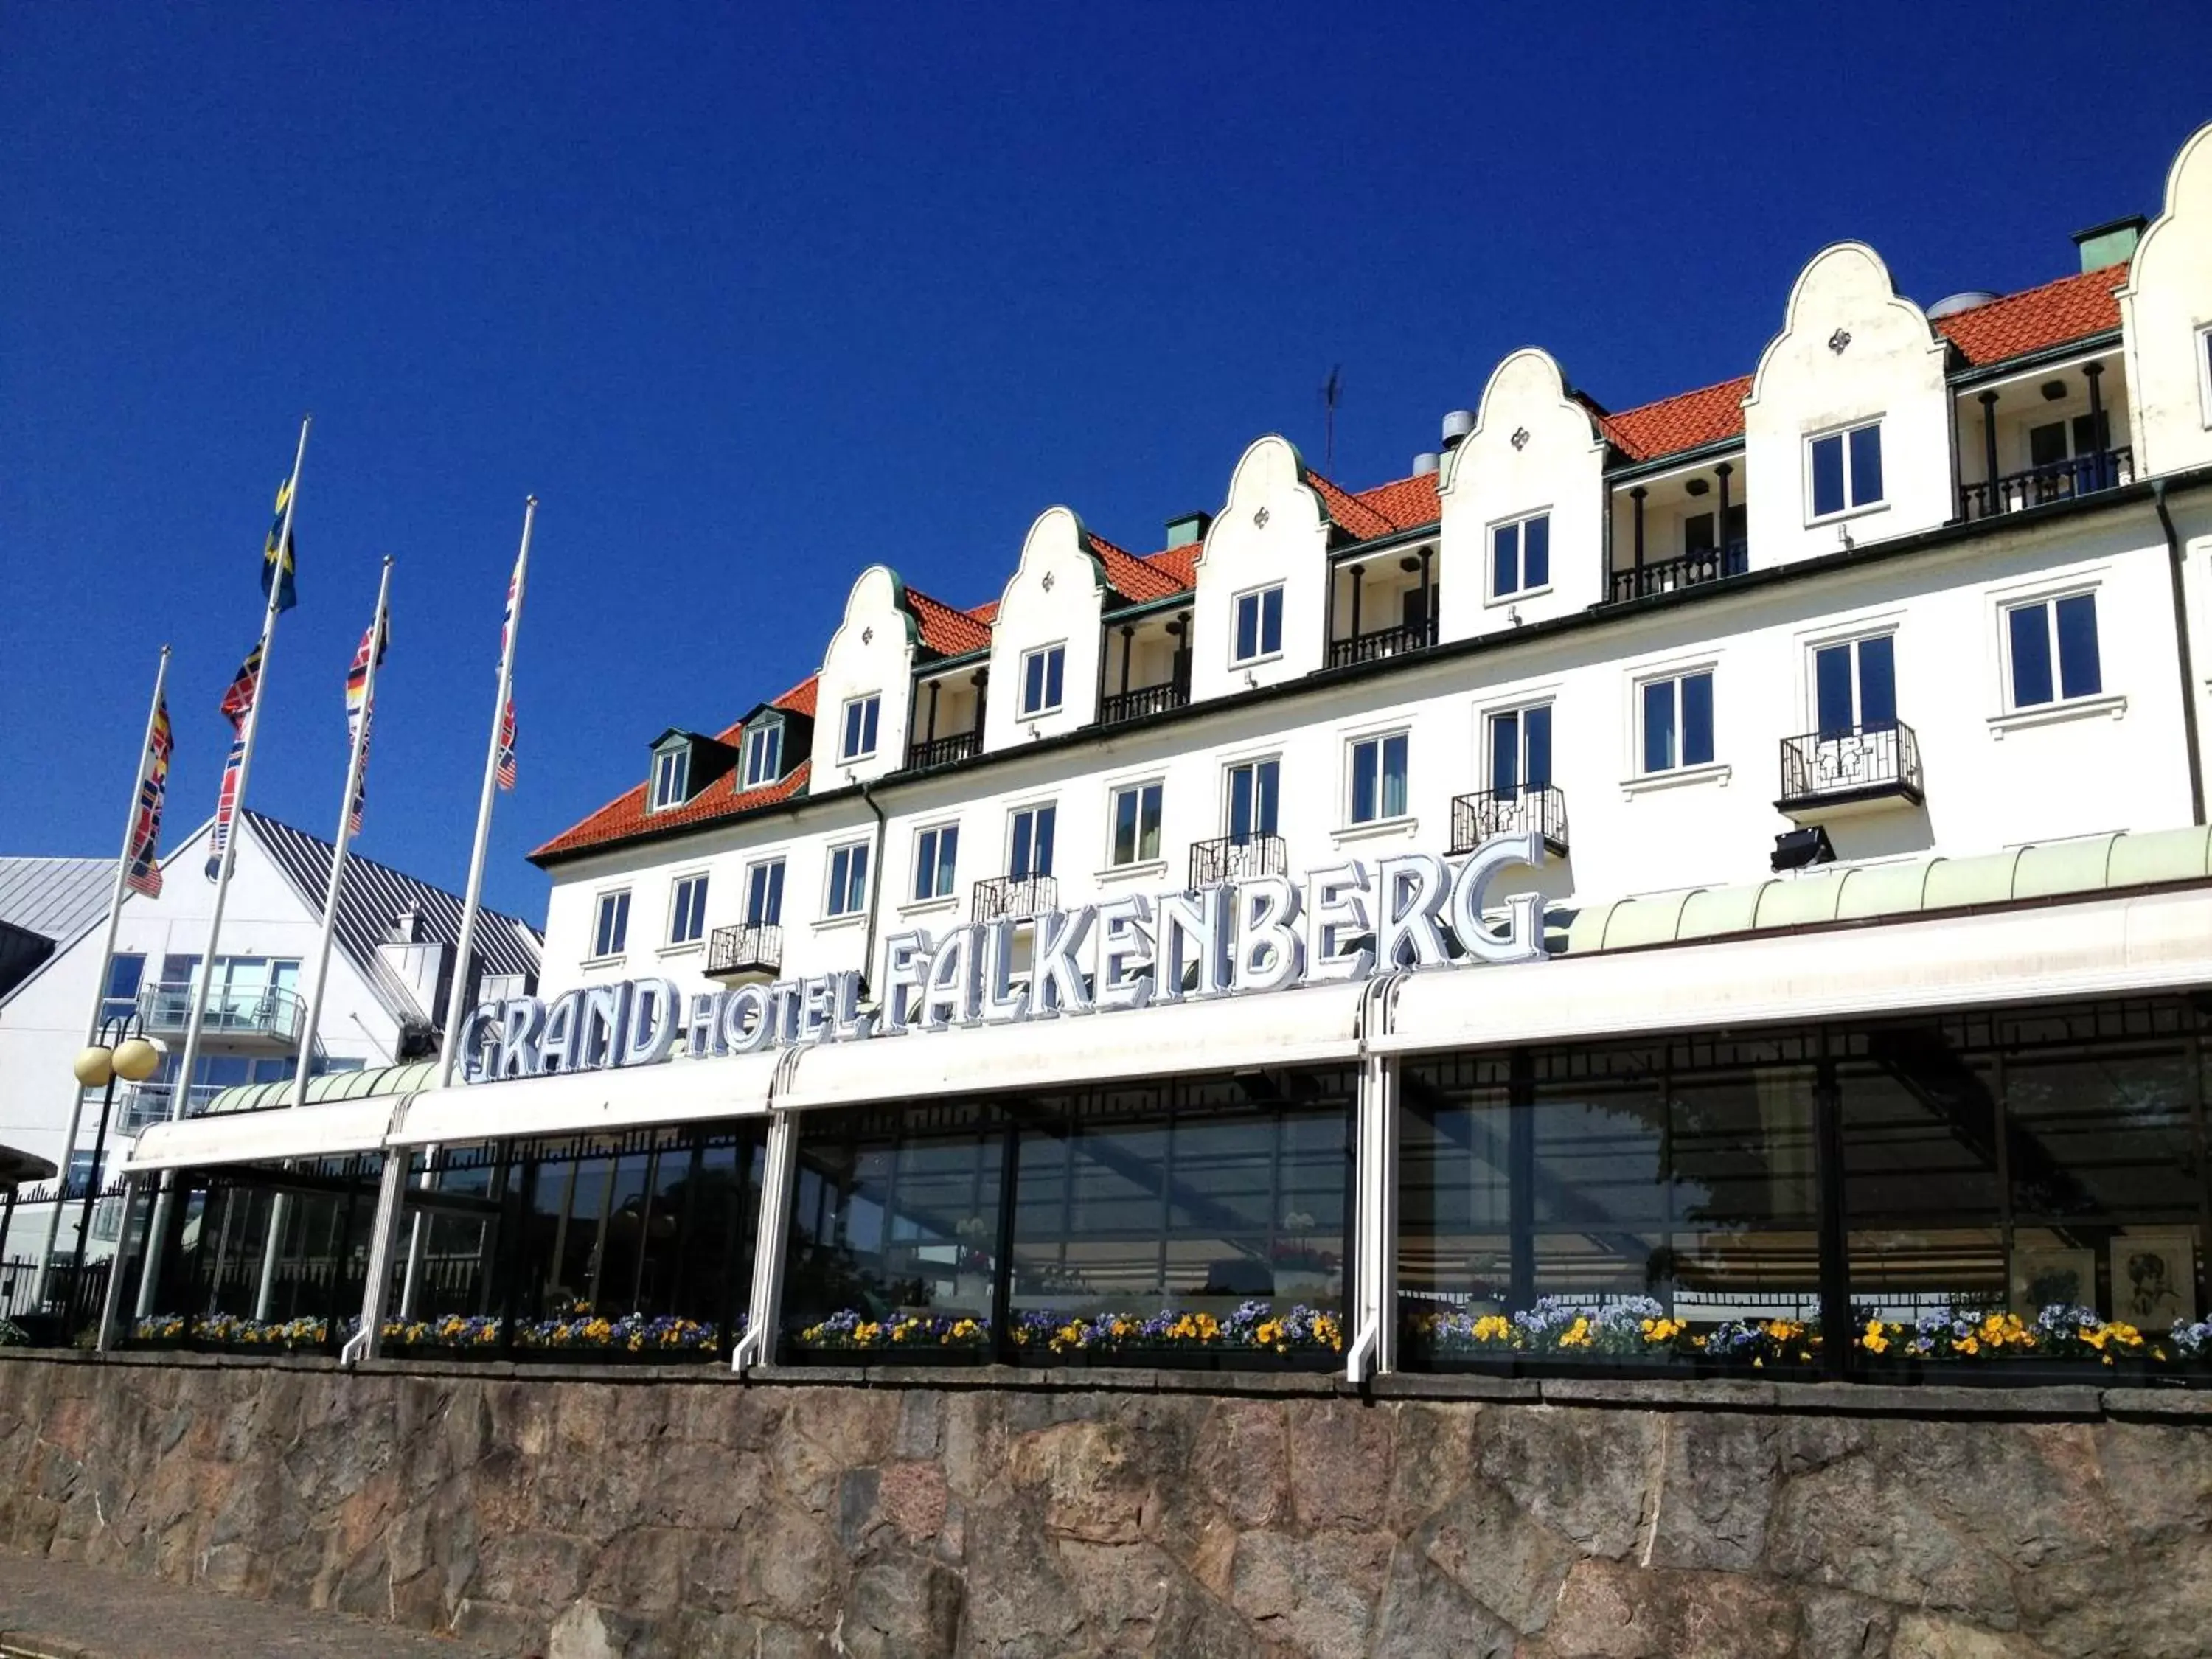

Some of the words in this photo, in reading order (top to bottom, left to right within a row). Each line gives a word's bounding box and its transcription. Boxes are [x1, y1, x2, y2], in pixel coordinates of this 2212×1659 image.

[458, 976, 681, 1084] GRAND
[685, 970, 872, 1058] HOTEL
[880, 831, 1551, 1034] FALKENBERG
